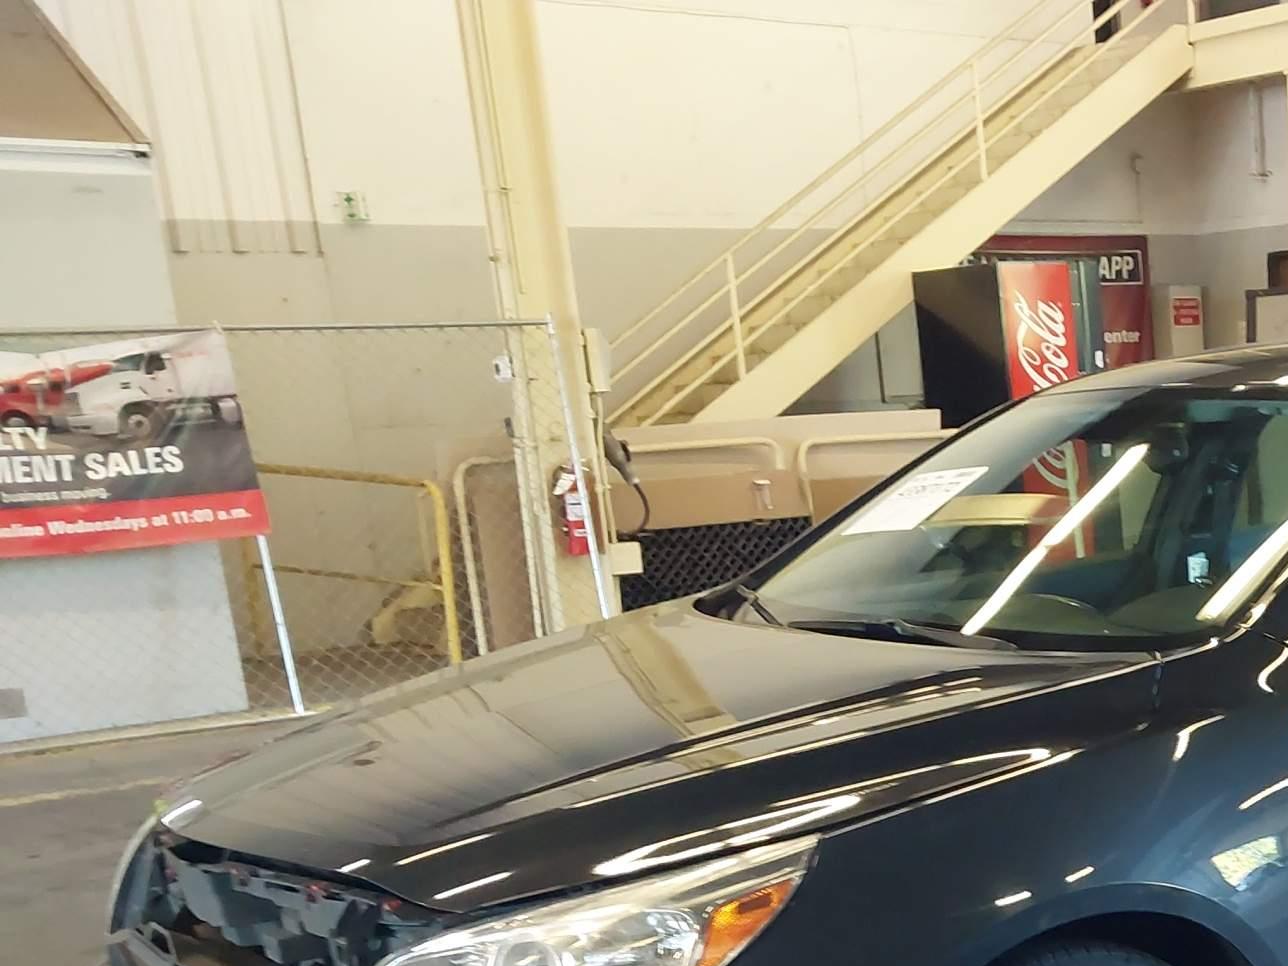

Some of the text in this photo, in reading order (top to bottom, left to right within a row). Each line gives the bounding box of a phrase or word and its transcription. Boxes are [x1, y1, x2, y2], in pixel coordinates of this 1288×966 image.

[1098, 255, 1135, 280] APP
[1013, 288, 1070, 392] Cola
[84, 445, 184, 480] SALES
[46, 516, 149, 535] Wednesdays
[151, 514, 169, 527] at
[171, 508, 215, 525] 11:00
